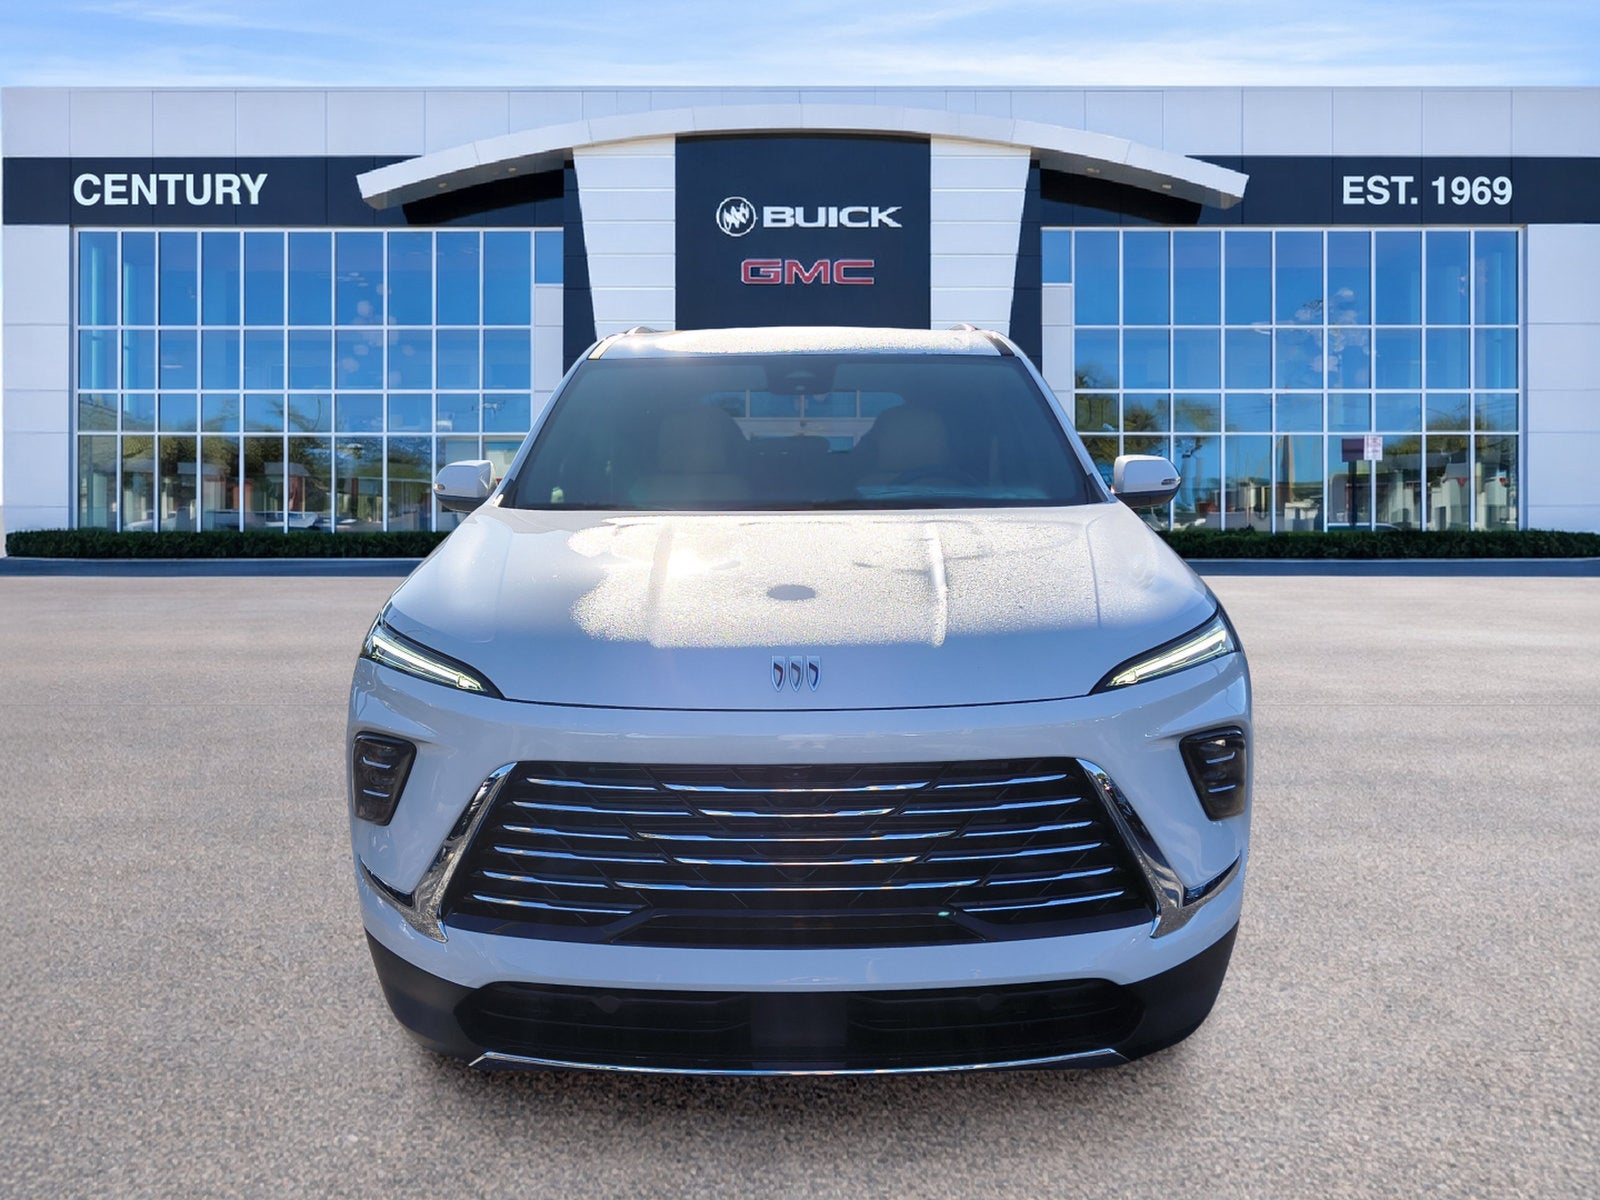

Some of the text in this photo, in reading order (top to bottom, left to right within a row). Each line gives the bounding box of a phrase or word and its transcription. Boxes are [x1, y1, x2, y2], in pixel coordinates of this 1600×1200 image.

[73, 173, 268, 206] CENTURY
[1342, 175, 1513, 206] EST. 1969
[762, 206, 903, 228] BUICK
[740, 258, 876, 285] GMC
